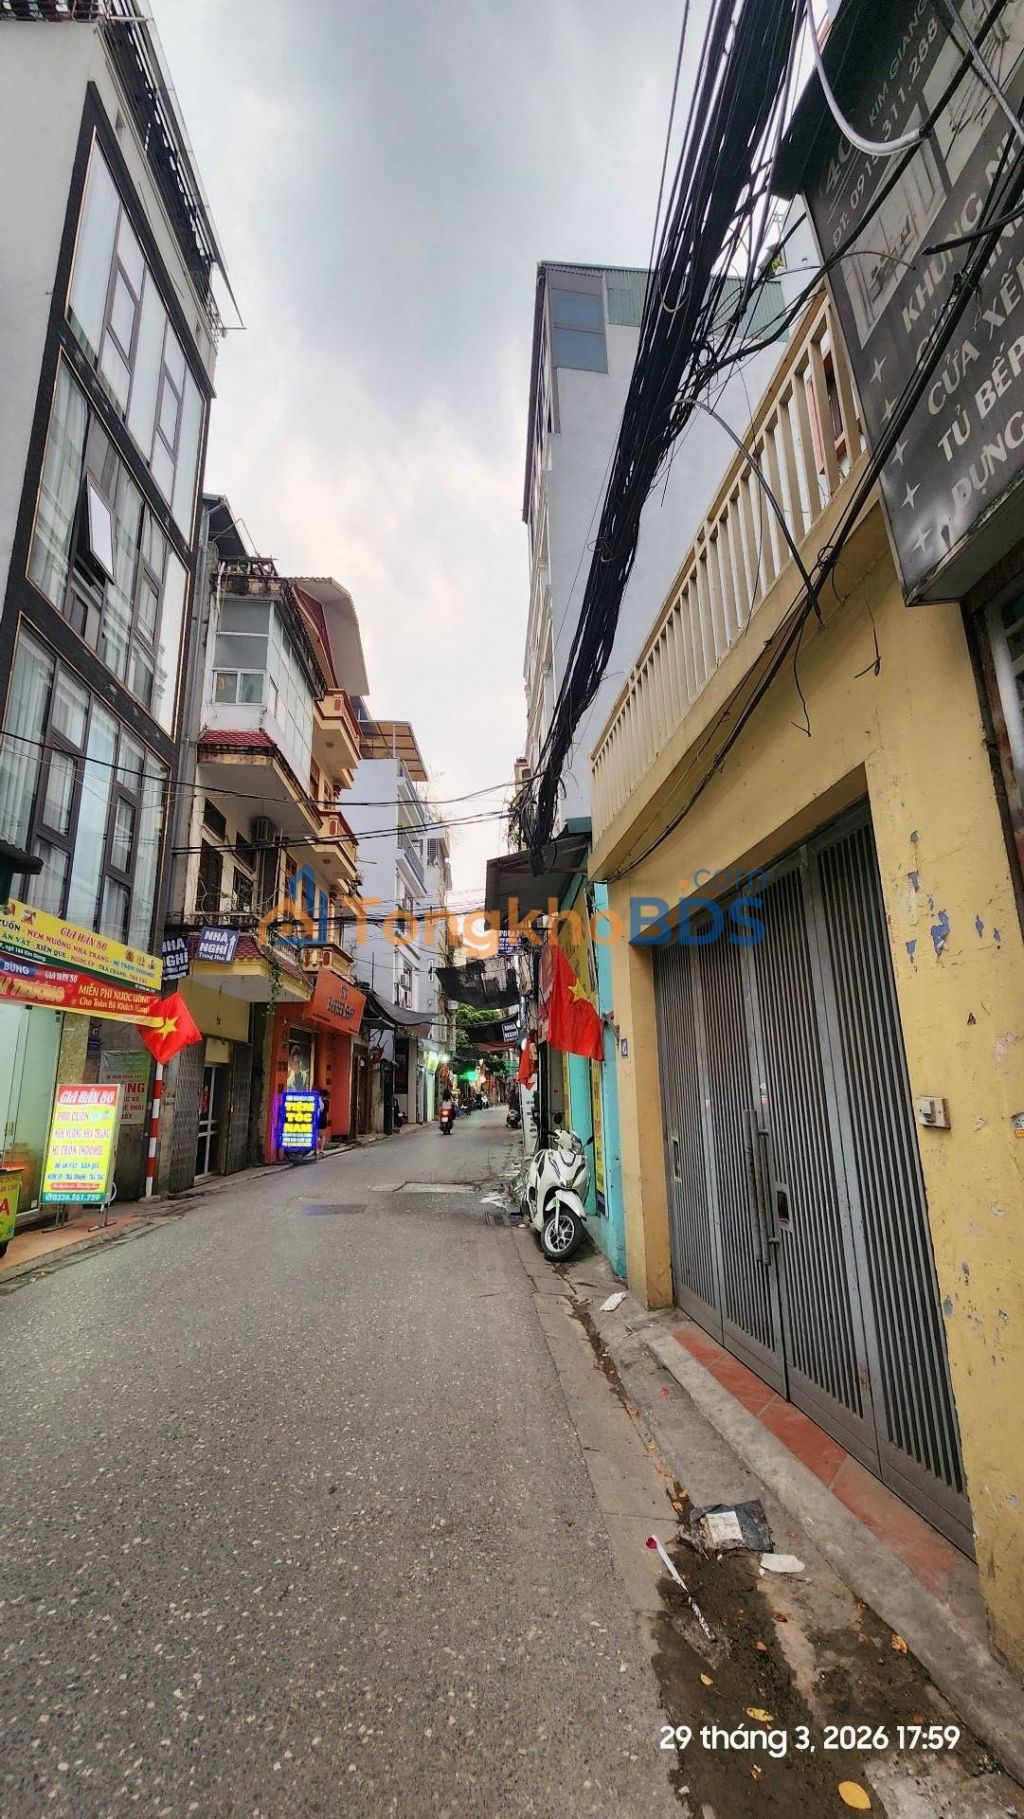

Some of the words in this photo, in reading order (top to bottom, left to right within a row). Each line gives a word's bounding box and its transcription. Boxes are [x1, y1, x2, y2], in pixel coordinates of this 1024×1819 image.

[869, 81, 889, 127] KIM
[928, 340, 982, 416] CỬA
[937, 403, 972, 462] TỦ
